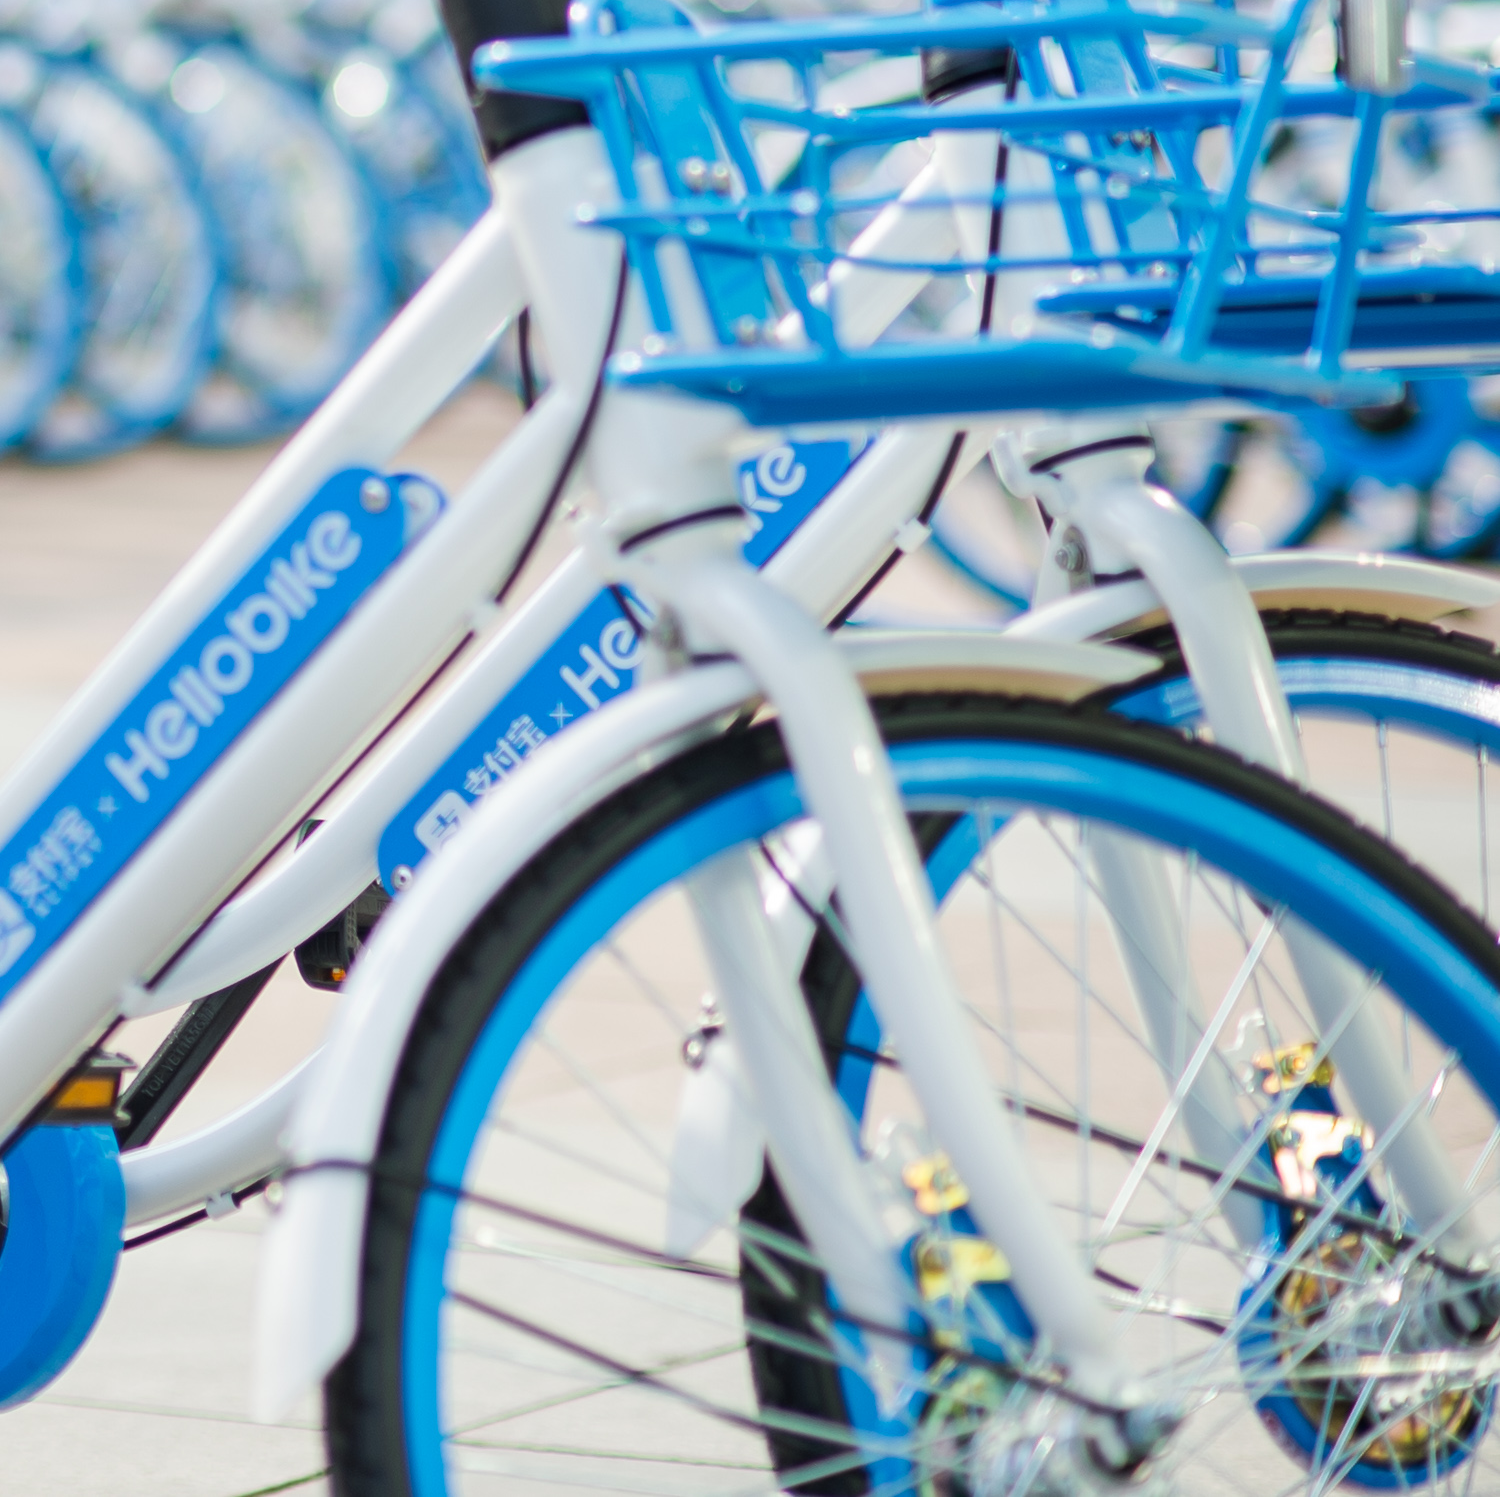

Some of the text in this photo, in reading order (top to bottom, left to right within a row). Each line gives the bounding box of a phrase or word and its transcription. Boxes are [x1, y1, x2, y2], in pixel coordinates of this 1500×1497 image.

[104, 510, 363, 804] Hellobike
[463, 714, 551, 796] 支付宝
